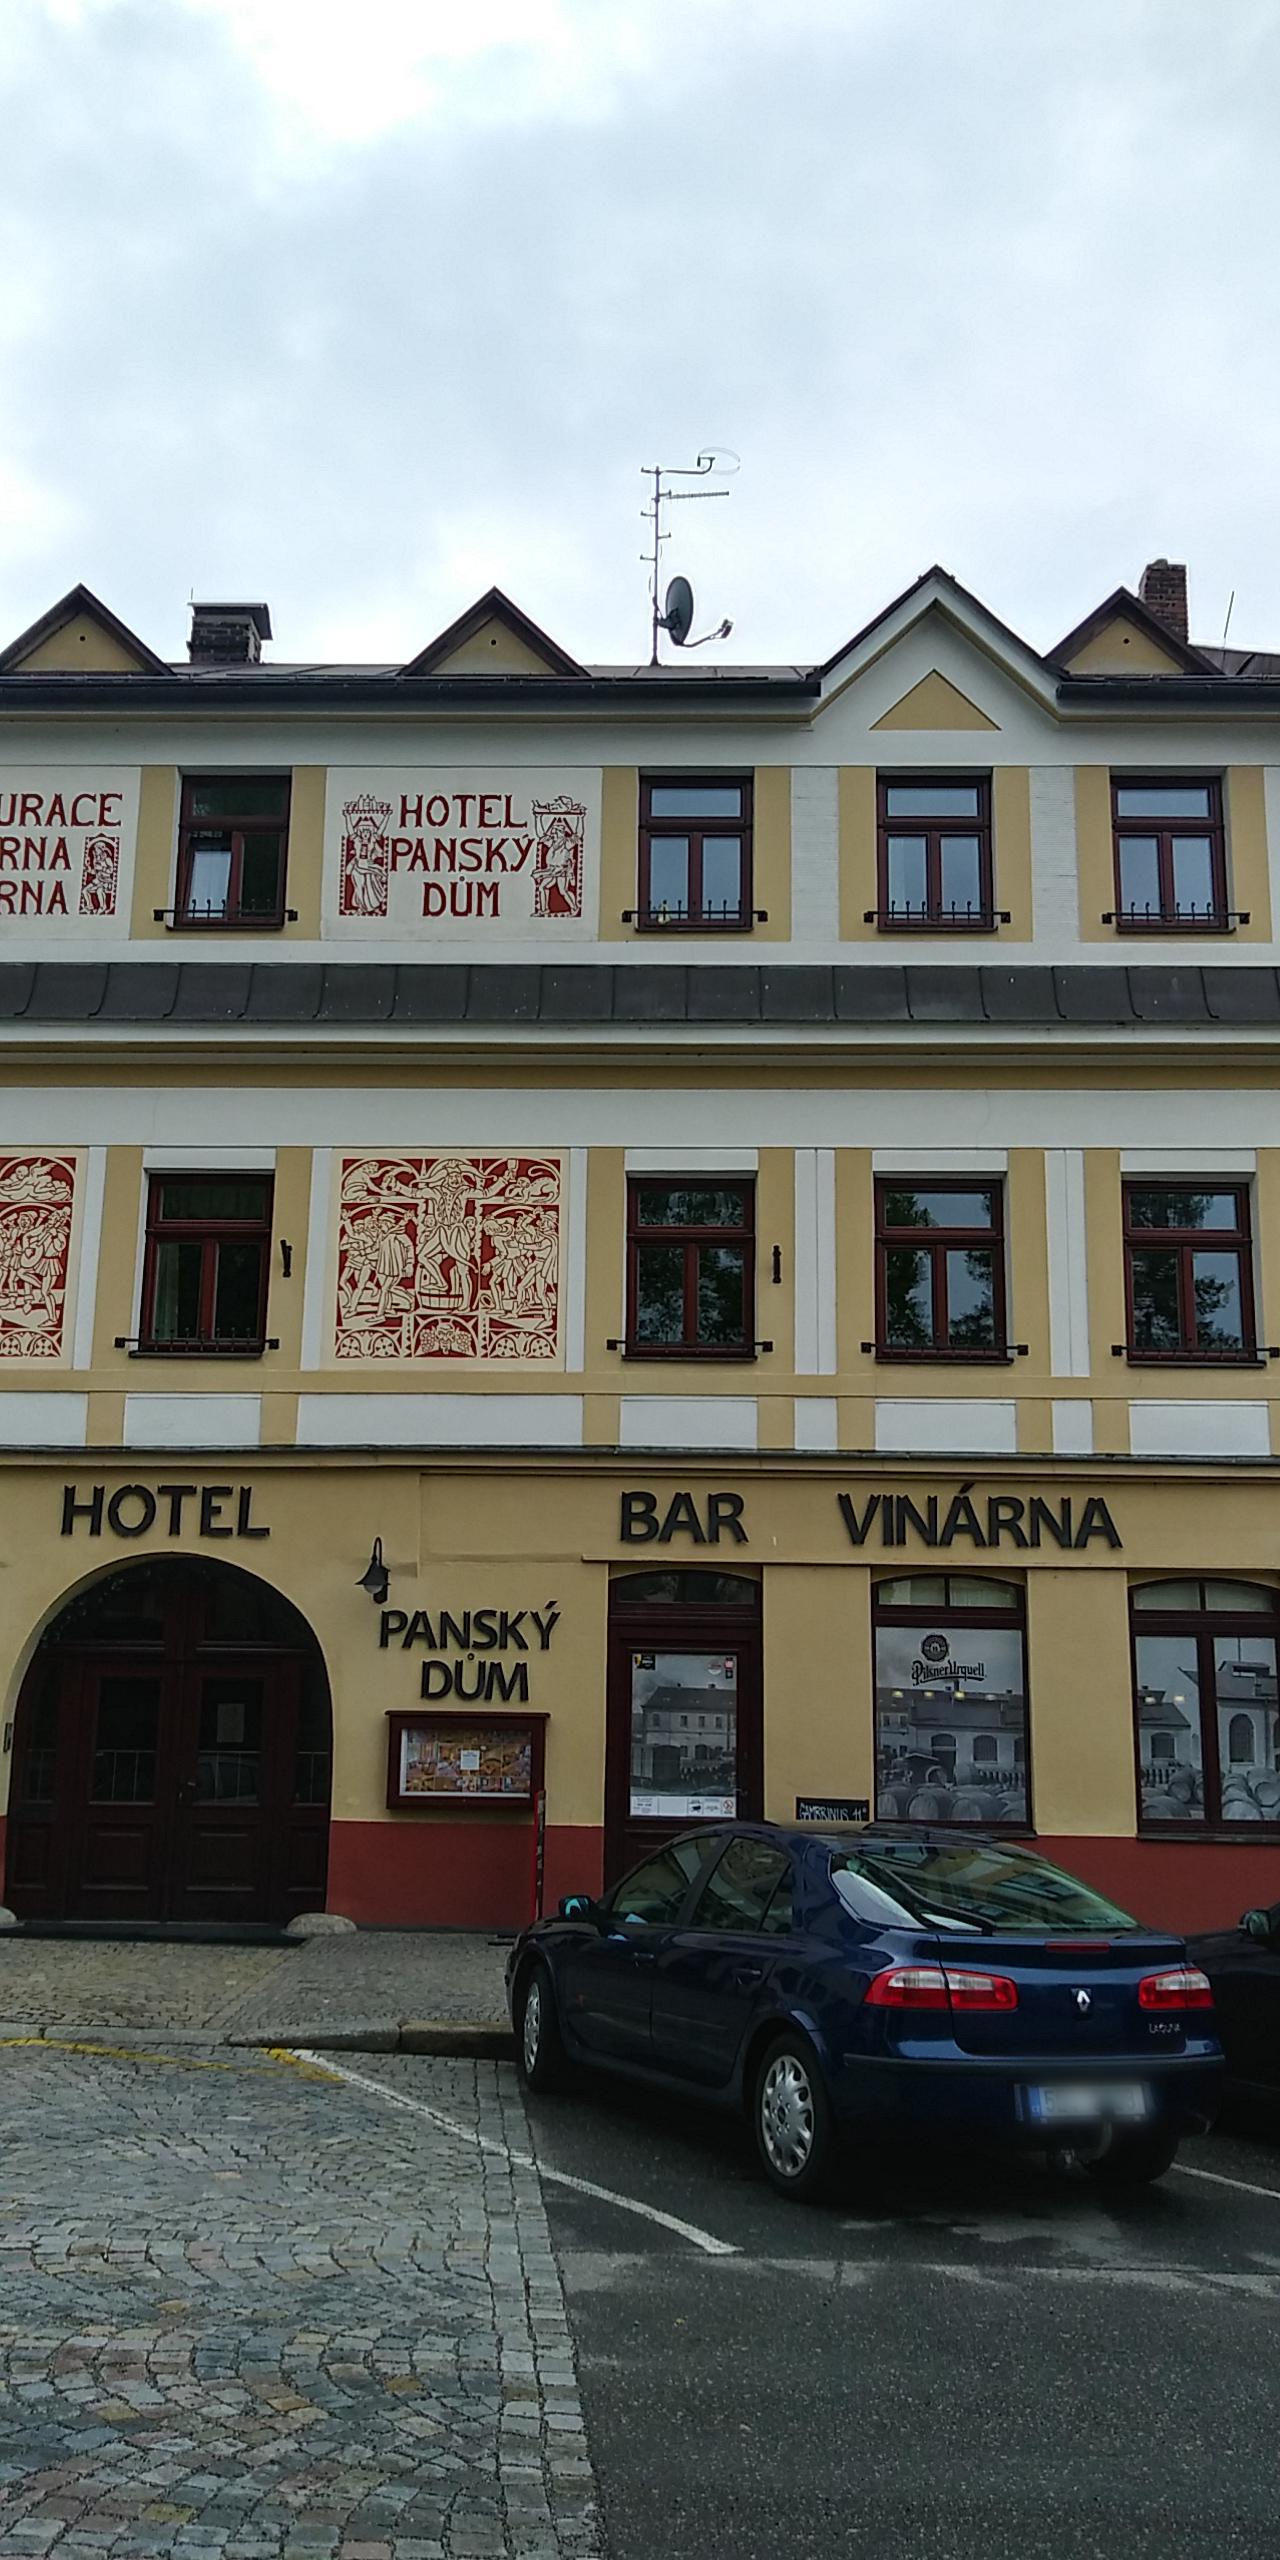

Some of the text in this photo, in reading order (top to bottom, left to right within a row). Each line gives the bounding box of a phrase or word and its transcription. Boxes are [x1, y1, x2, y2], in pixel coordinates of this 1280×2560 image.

[399, 794, 528, 829] HOTEL
[390, 833, 536, 873] PANSKÝ
[422, 875, 501, 918] DŮM
[60, 1484, 271, 1538] HOTEL
[619, 1482, 1124, 1549] BAR VINÁRNA
[379, 1600, 562, 1651] PANSKÝ
[420, 1652, 530, 1702] DŮM
[911, 1659, 985, 1687] Pilsner Urquell
